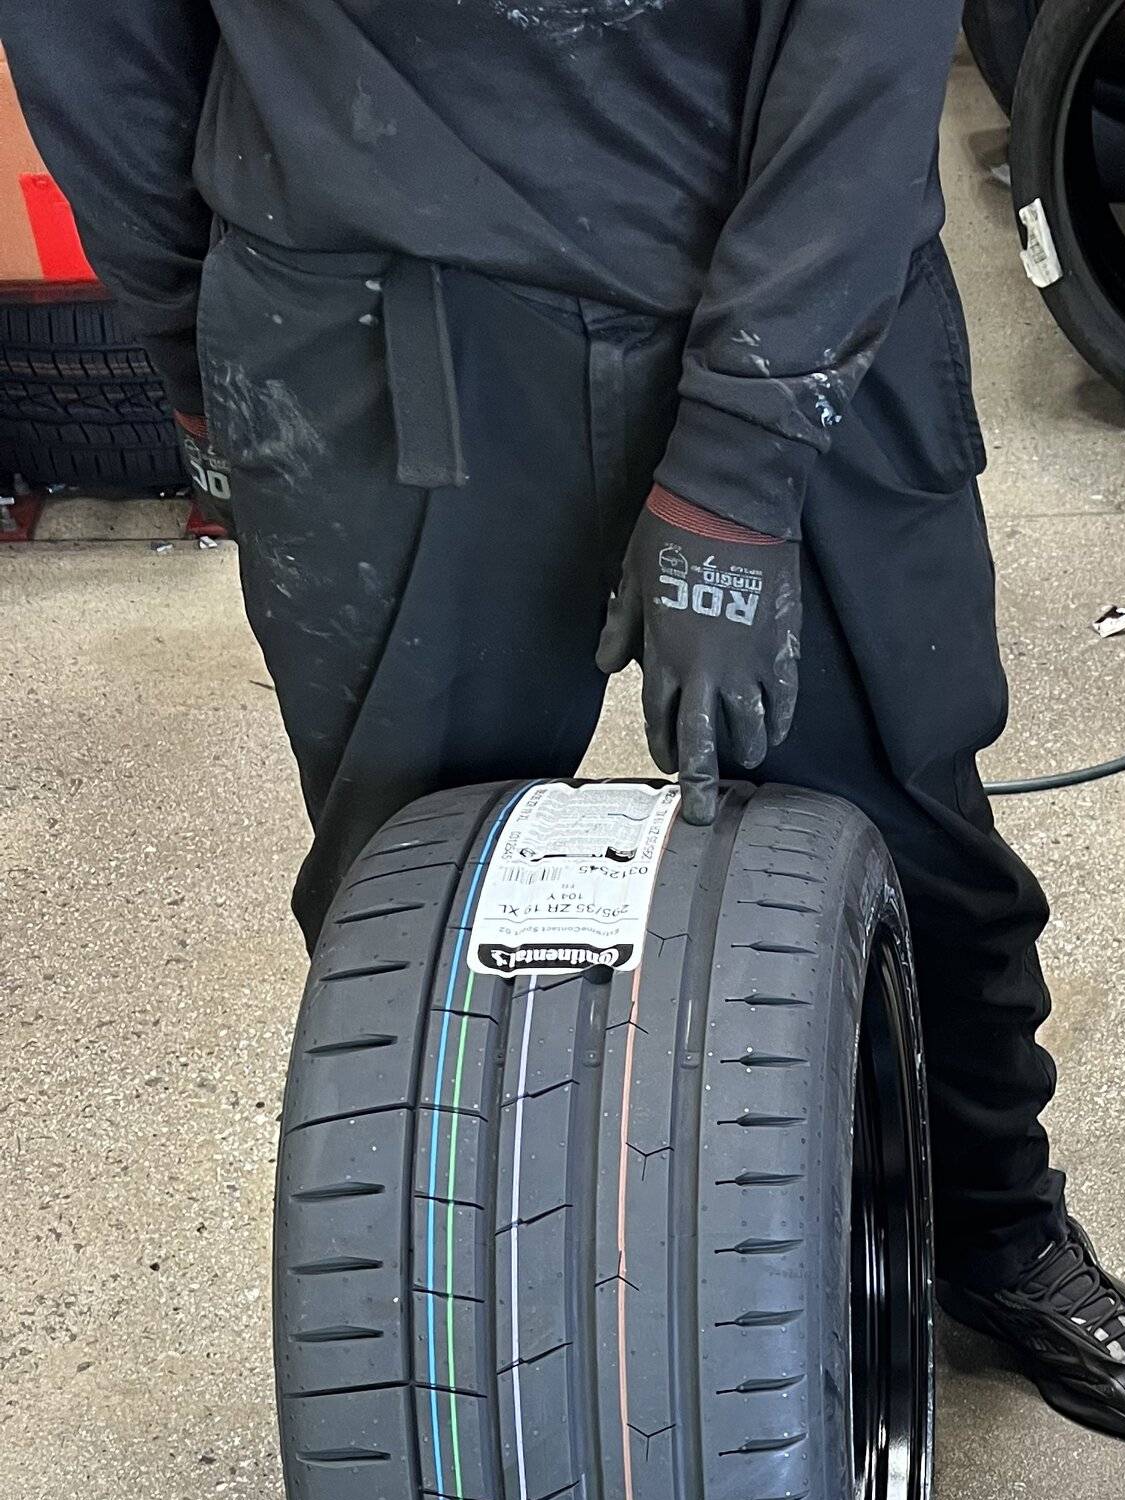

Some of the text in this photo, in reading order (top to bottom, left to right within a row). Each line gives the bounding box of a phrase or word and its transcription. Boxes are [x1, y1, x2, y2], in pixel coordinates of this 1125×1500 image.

[189, 460, 231, 499] OC
[702, 555, 717, 569] 7
[703, 569, 763, 592] MAGID
[660, 574, 760, 626] ROC
[498, 903, 521, 917] XL
[547, 903, 572, 914] ZR
[505, 947, 620, 968] Continental
